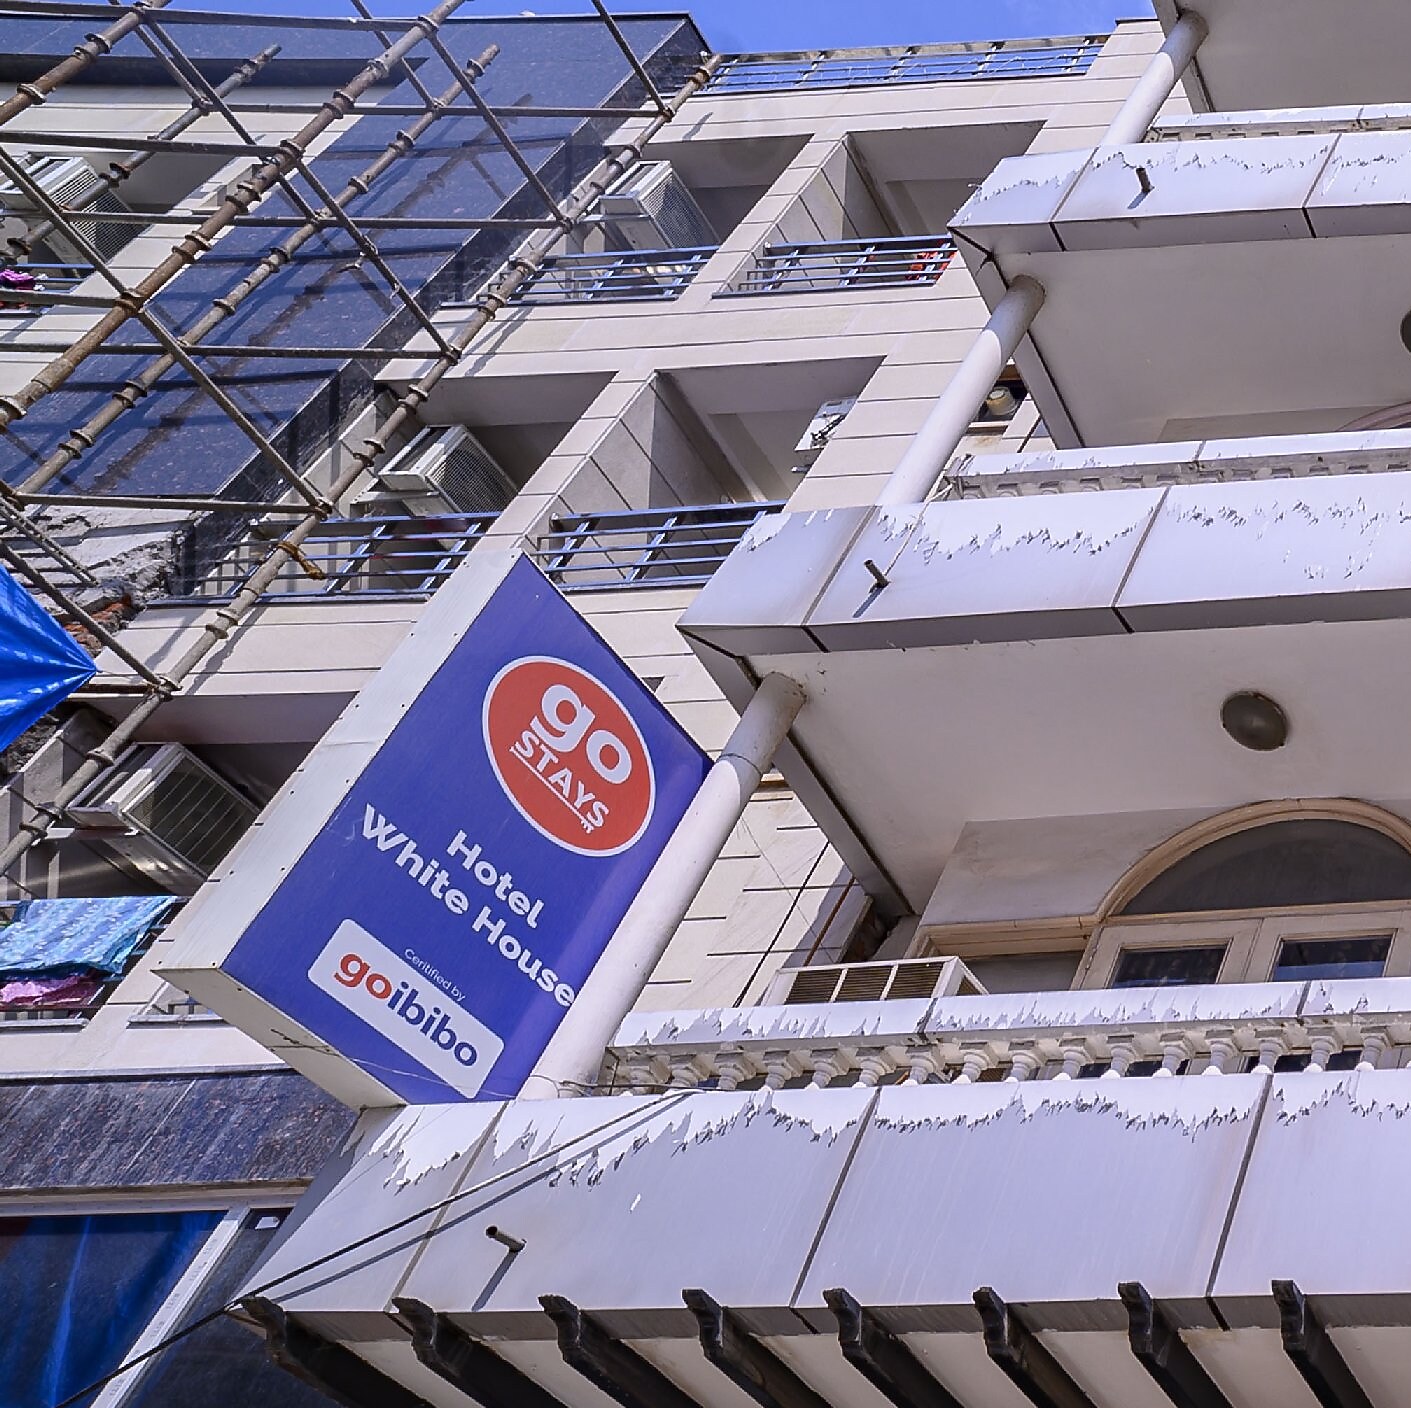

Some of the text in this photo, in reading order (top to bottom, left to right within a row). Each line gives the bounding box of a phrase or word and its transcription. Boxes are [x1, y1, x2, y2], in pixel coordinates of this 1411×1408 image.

[513, 728, 610, 828] STAYS
[530, 684, 632, 785] go
[363, 803, 577, 1008] White House
[446, 829, 545, 929] Hotel
[333, 952, 478, 1067] goibibo
[451, 986, 466, 1002] by
